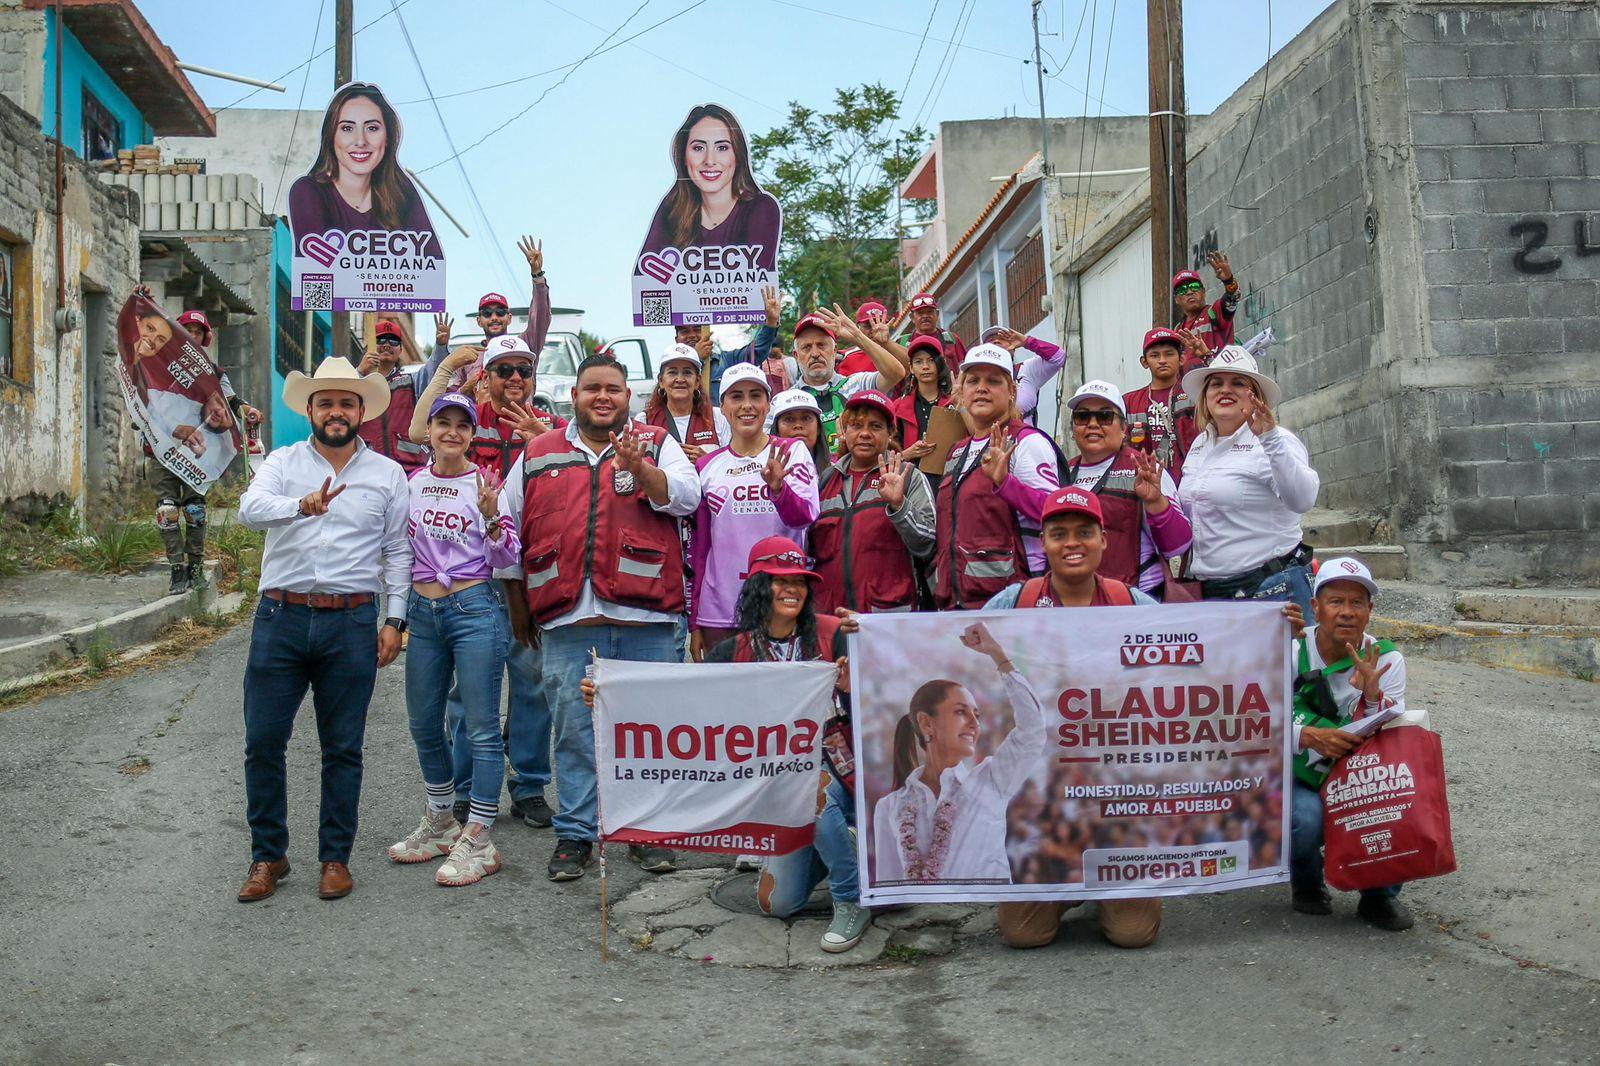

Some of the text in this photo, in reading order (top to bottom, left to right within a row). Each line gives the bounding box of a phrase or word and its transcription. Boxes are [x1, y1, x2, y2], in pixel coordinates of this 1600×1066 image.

[347, 232, 429, 256] CECY
[340, 258, 436, 270] GUADIANA
[682, 248, 758, 272] CECY
[363, 282, 414, 292] morena
[676, 272, 768, 285] GUADIANA
[402, 302, 432, 311] JUNIO
[700, 296, 748, 306] morena
[738, 314, 766, 322] JUNIO
[181, 344, 213, 375] morena
[169, 364, 191, 389] VOTA
[163, 452, 203, 486] CASTRO
[168, 446, 208, 480] ANTONIO
[1076, 476, 1100, 485] oren
[422, 486, 459, 496] morena
[733, 484, 770, 501] CEC
[1066, 493, 1088, 503] CECY
[422, 508, 474, 534] CECY
[1124, 632, 1198, 644] 2 DE JUNIO
[1122, 645, 1201, 665] VOTA
[1057, 682, 1270, 721] CLAUDIA
[614, 718, 819, 763] morena
[1058, 716, 1270, 748] SHEINBAUM
[1103, 750, 1230, 765] PRESIDENTA
[1348, 758, 1378, 768] VOTA
[615, 758, 814, 784] La esperanza de México
[1326, 763, 1413, 794] CLAUDIA
[1064, 776, 1263, 798] HONESTIDAD, RESULTADOS Y
[1326, 777, 1415, 806] SHEINBAUM
[1104, 798, 1232, 816] AMOR AL PUEBLO
[1342, 792, 1396, 810] PRESIDENTA
[1361, 832, 1392, 844] morena
[1146, 852, 1189, 861] HACIENDO
[1191, 849, 1227, 859] HISTORIA
[1098, 861, 1196, 882] morena
[1202, 865, 1216, 875] PT
